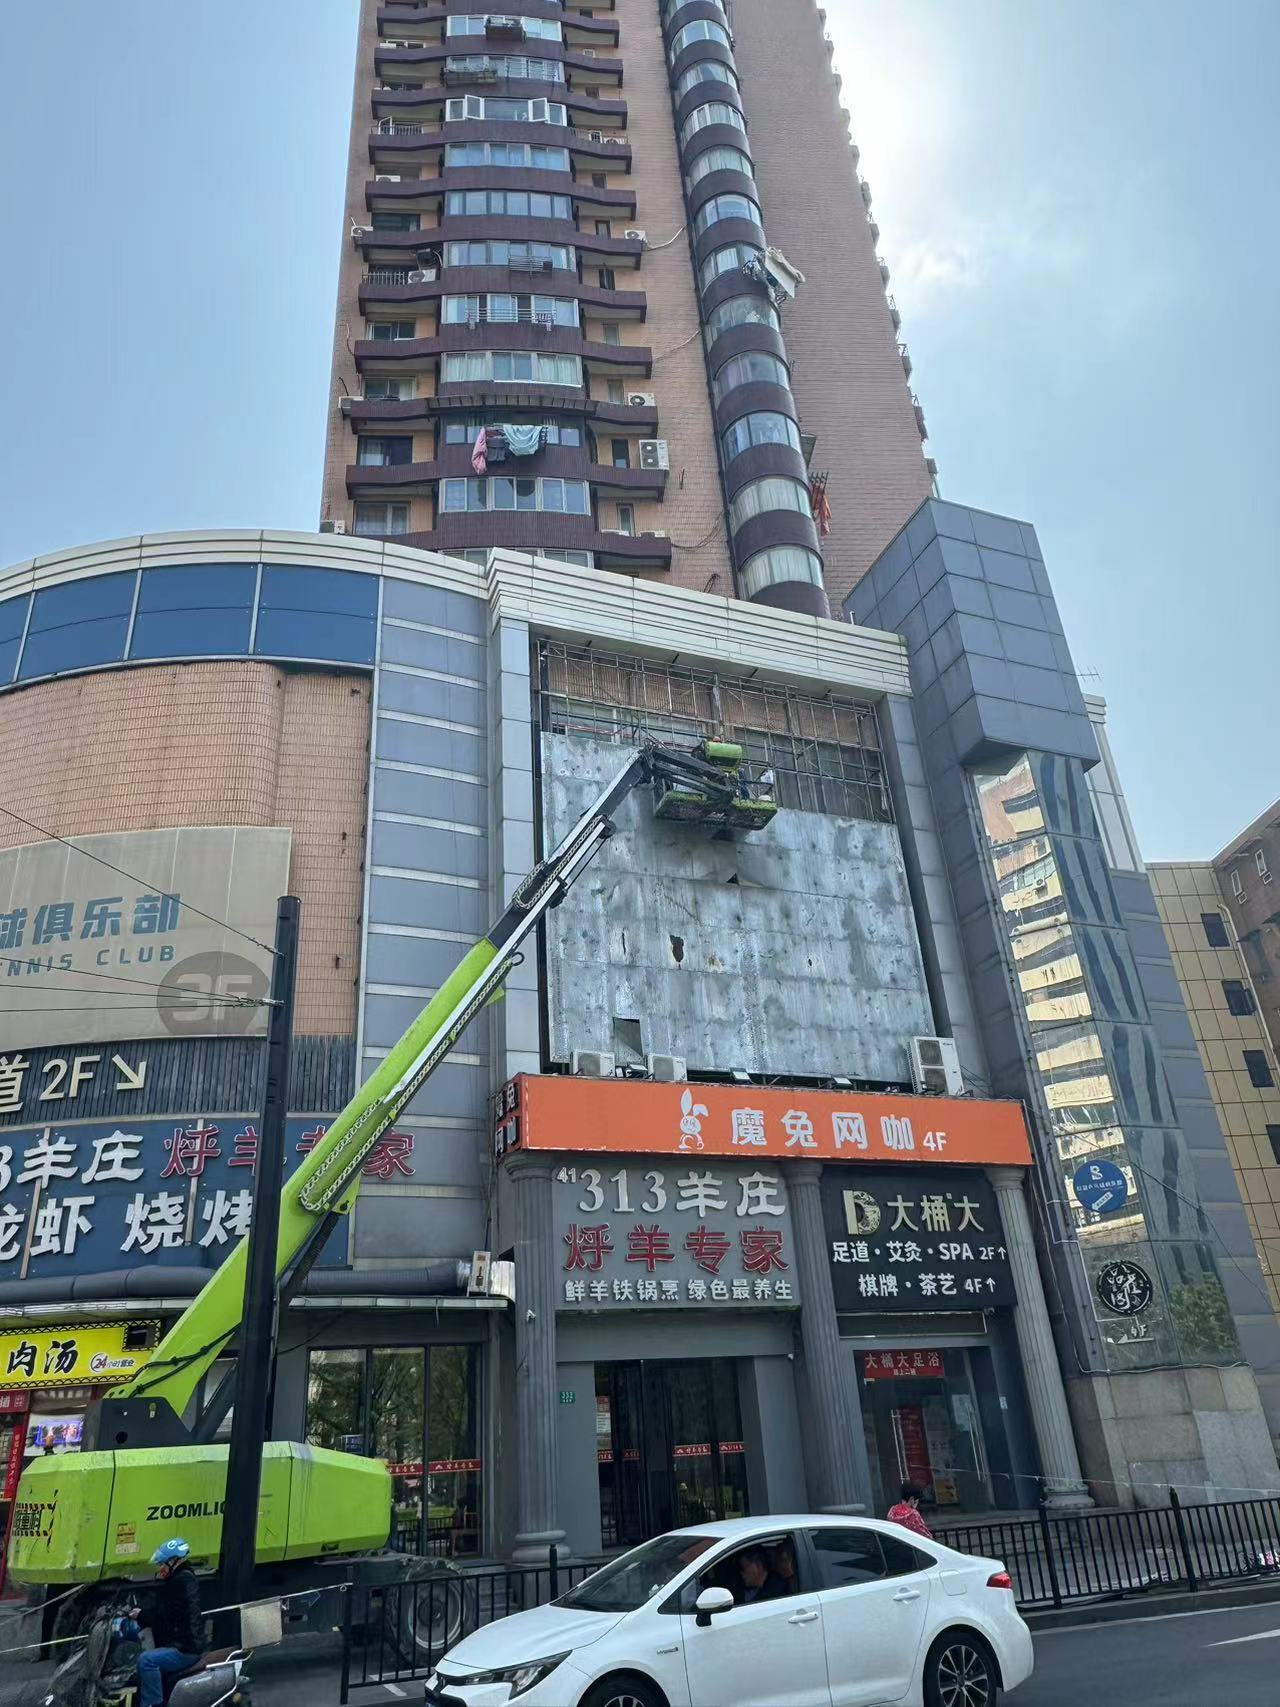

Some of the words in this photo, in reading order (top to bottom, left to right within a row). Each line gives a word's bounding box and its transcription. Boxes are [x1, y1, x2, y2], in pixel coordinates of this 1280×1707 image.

[0, 953, 72, 977] NNIS
[97, 945, 175, 966] CLUB
[39, 1055, 101, 1101] 2F
[731, 1107, 915, 1150] 魔兔网咖
[923, 1131, 947, 1151] 4F
[578, 1168, 787, 1218] 313羊庄
[886, 1193, 985, 1233] 大桶大
[979, 1247, 995, 1260] 2F
[564, 1279, 680, 1302] 鲜羊铁锅烹
[687, 1278, 794, 1301] 绿色最养生
[964, 1278, 982, 1293] 4F
